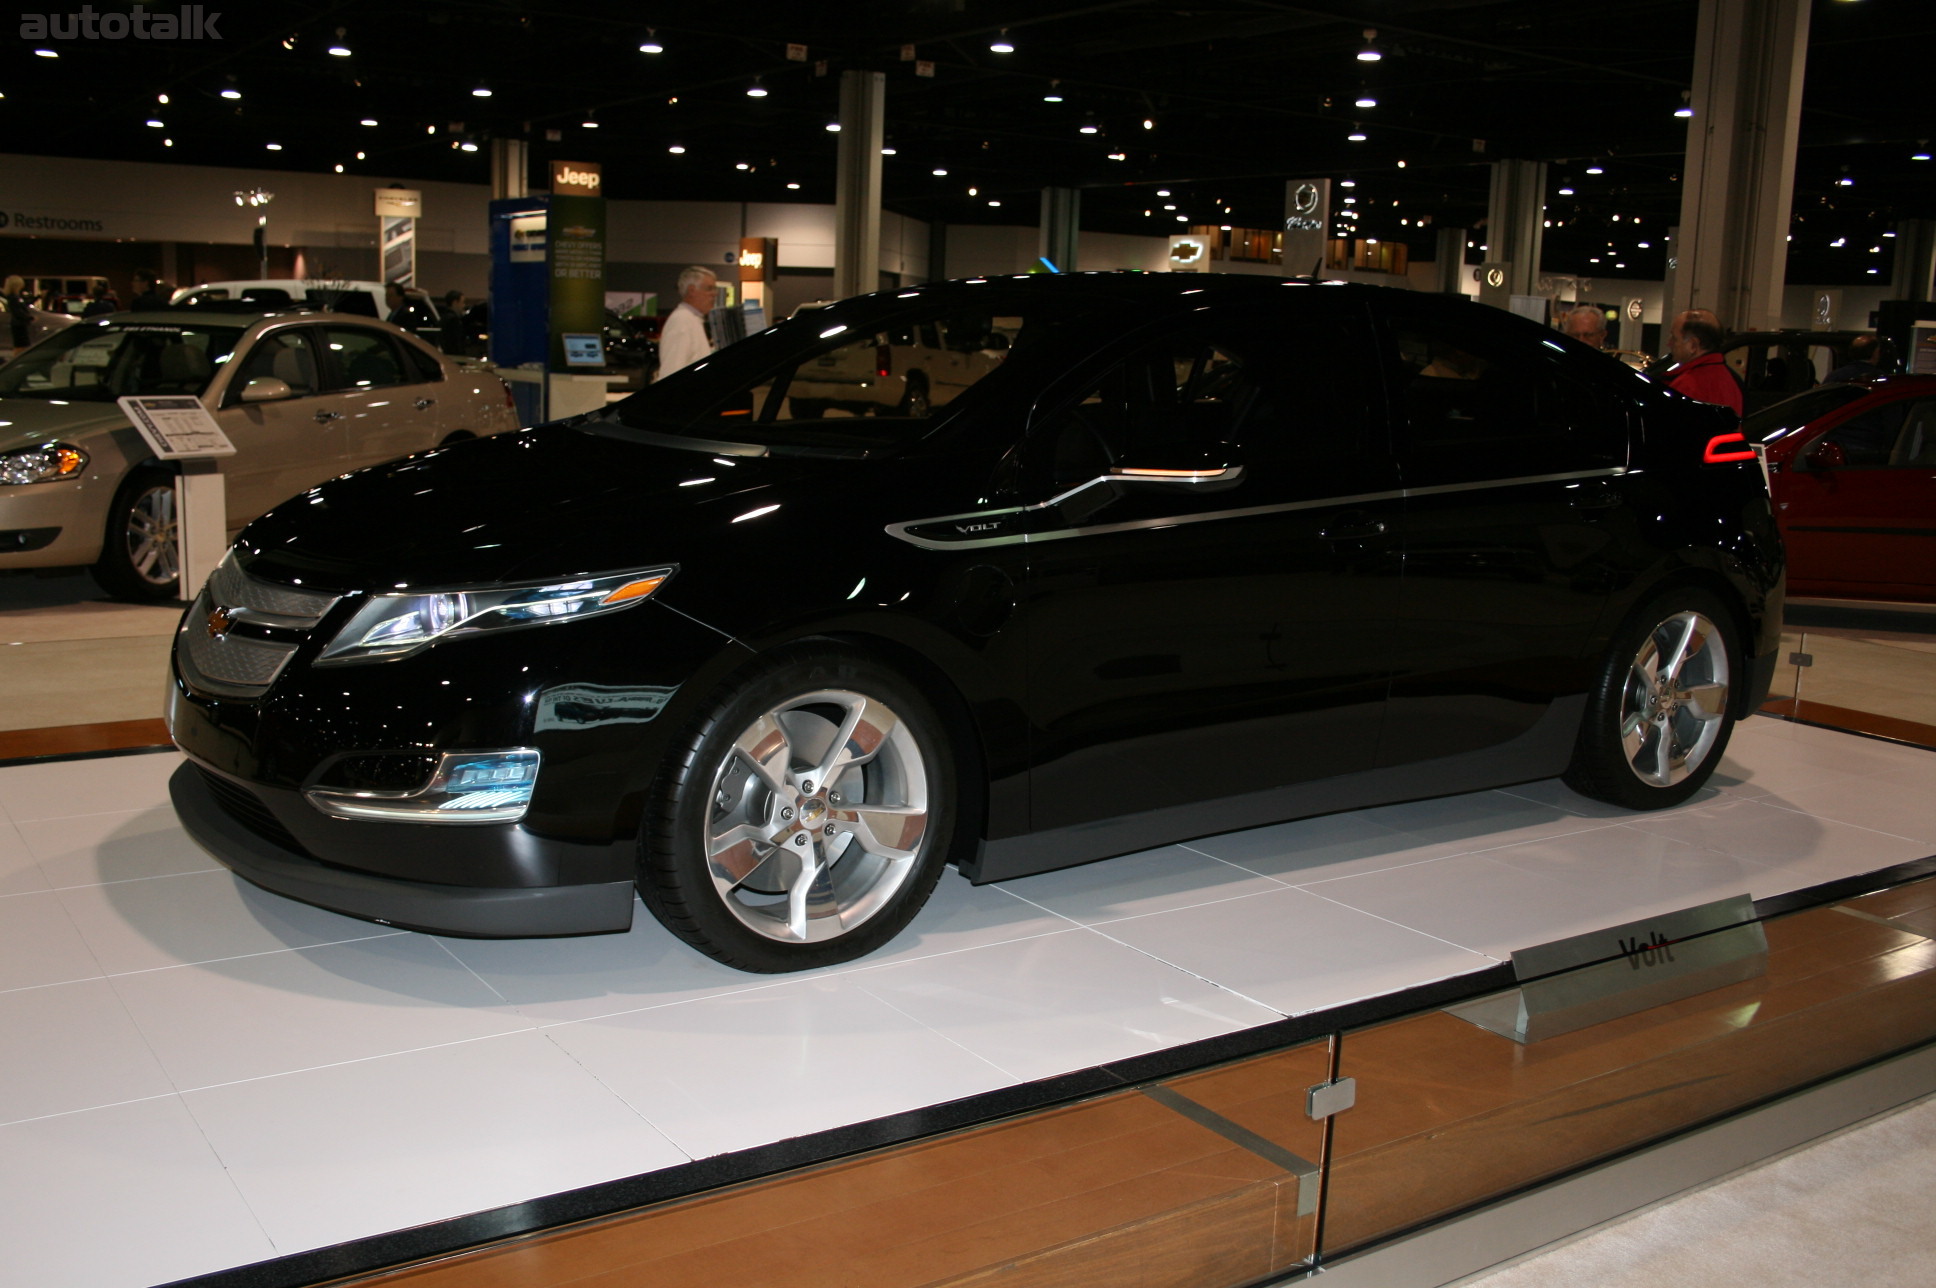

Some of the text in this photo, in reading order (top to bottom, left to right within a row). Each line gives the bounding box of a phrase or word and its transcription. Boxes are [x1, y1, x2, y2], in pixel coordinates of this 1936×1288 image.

[556, 166, 600, 189] Jeep
[13, 212, 104, 232] Restrooms
[739, 249, 763, 269] Jeep
[554, 268, 602, 280] OR BETTER
[955, 522, 1001, 535] VOLT
[1618, 931, 1675, 971] Volt
